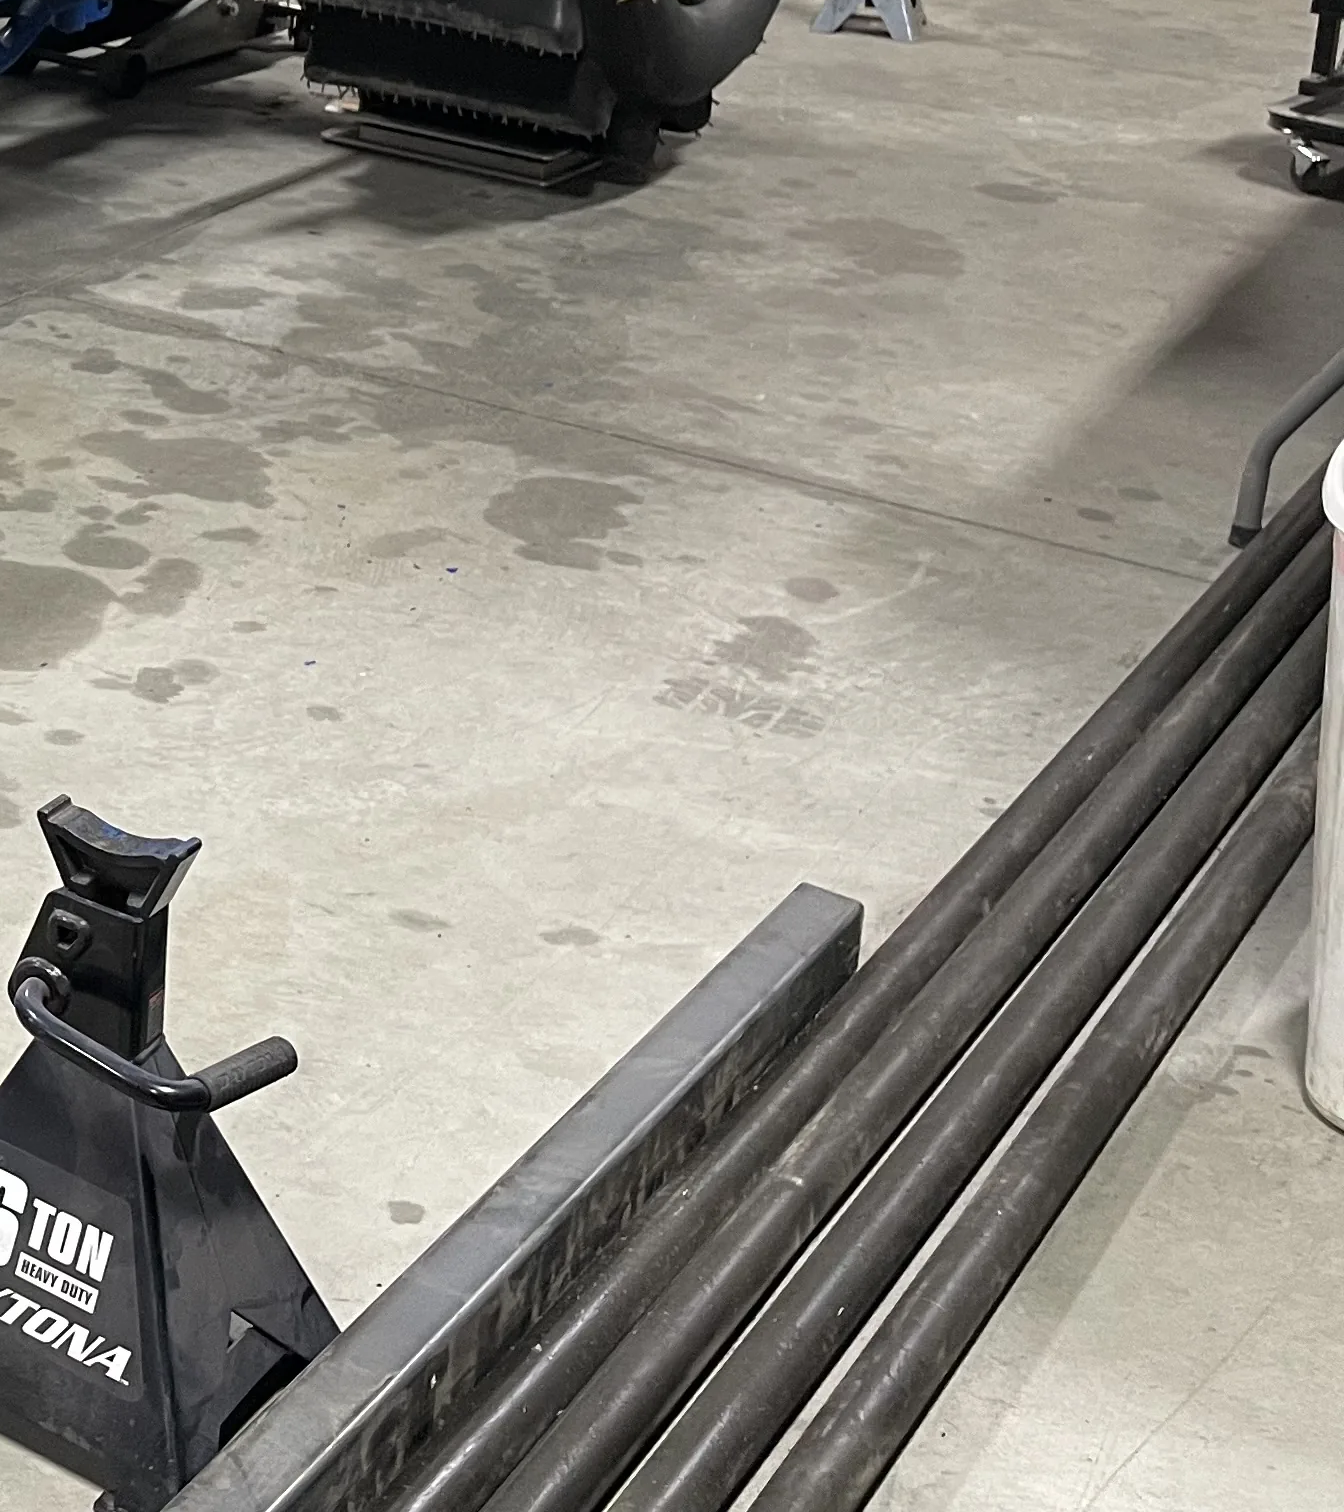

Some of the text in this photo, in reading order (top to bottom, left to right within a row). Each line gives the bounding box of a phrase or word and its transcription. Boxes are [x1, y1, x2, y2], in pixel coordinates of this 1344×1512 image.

[28, 1198, 114, 1282] TON
[21, 1258, 93, 1306] HEAVY DUTY
